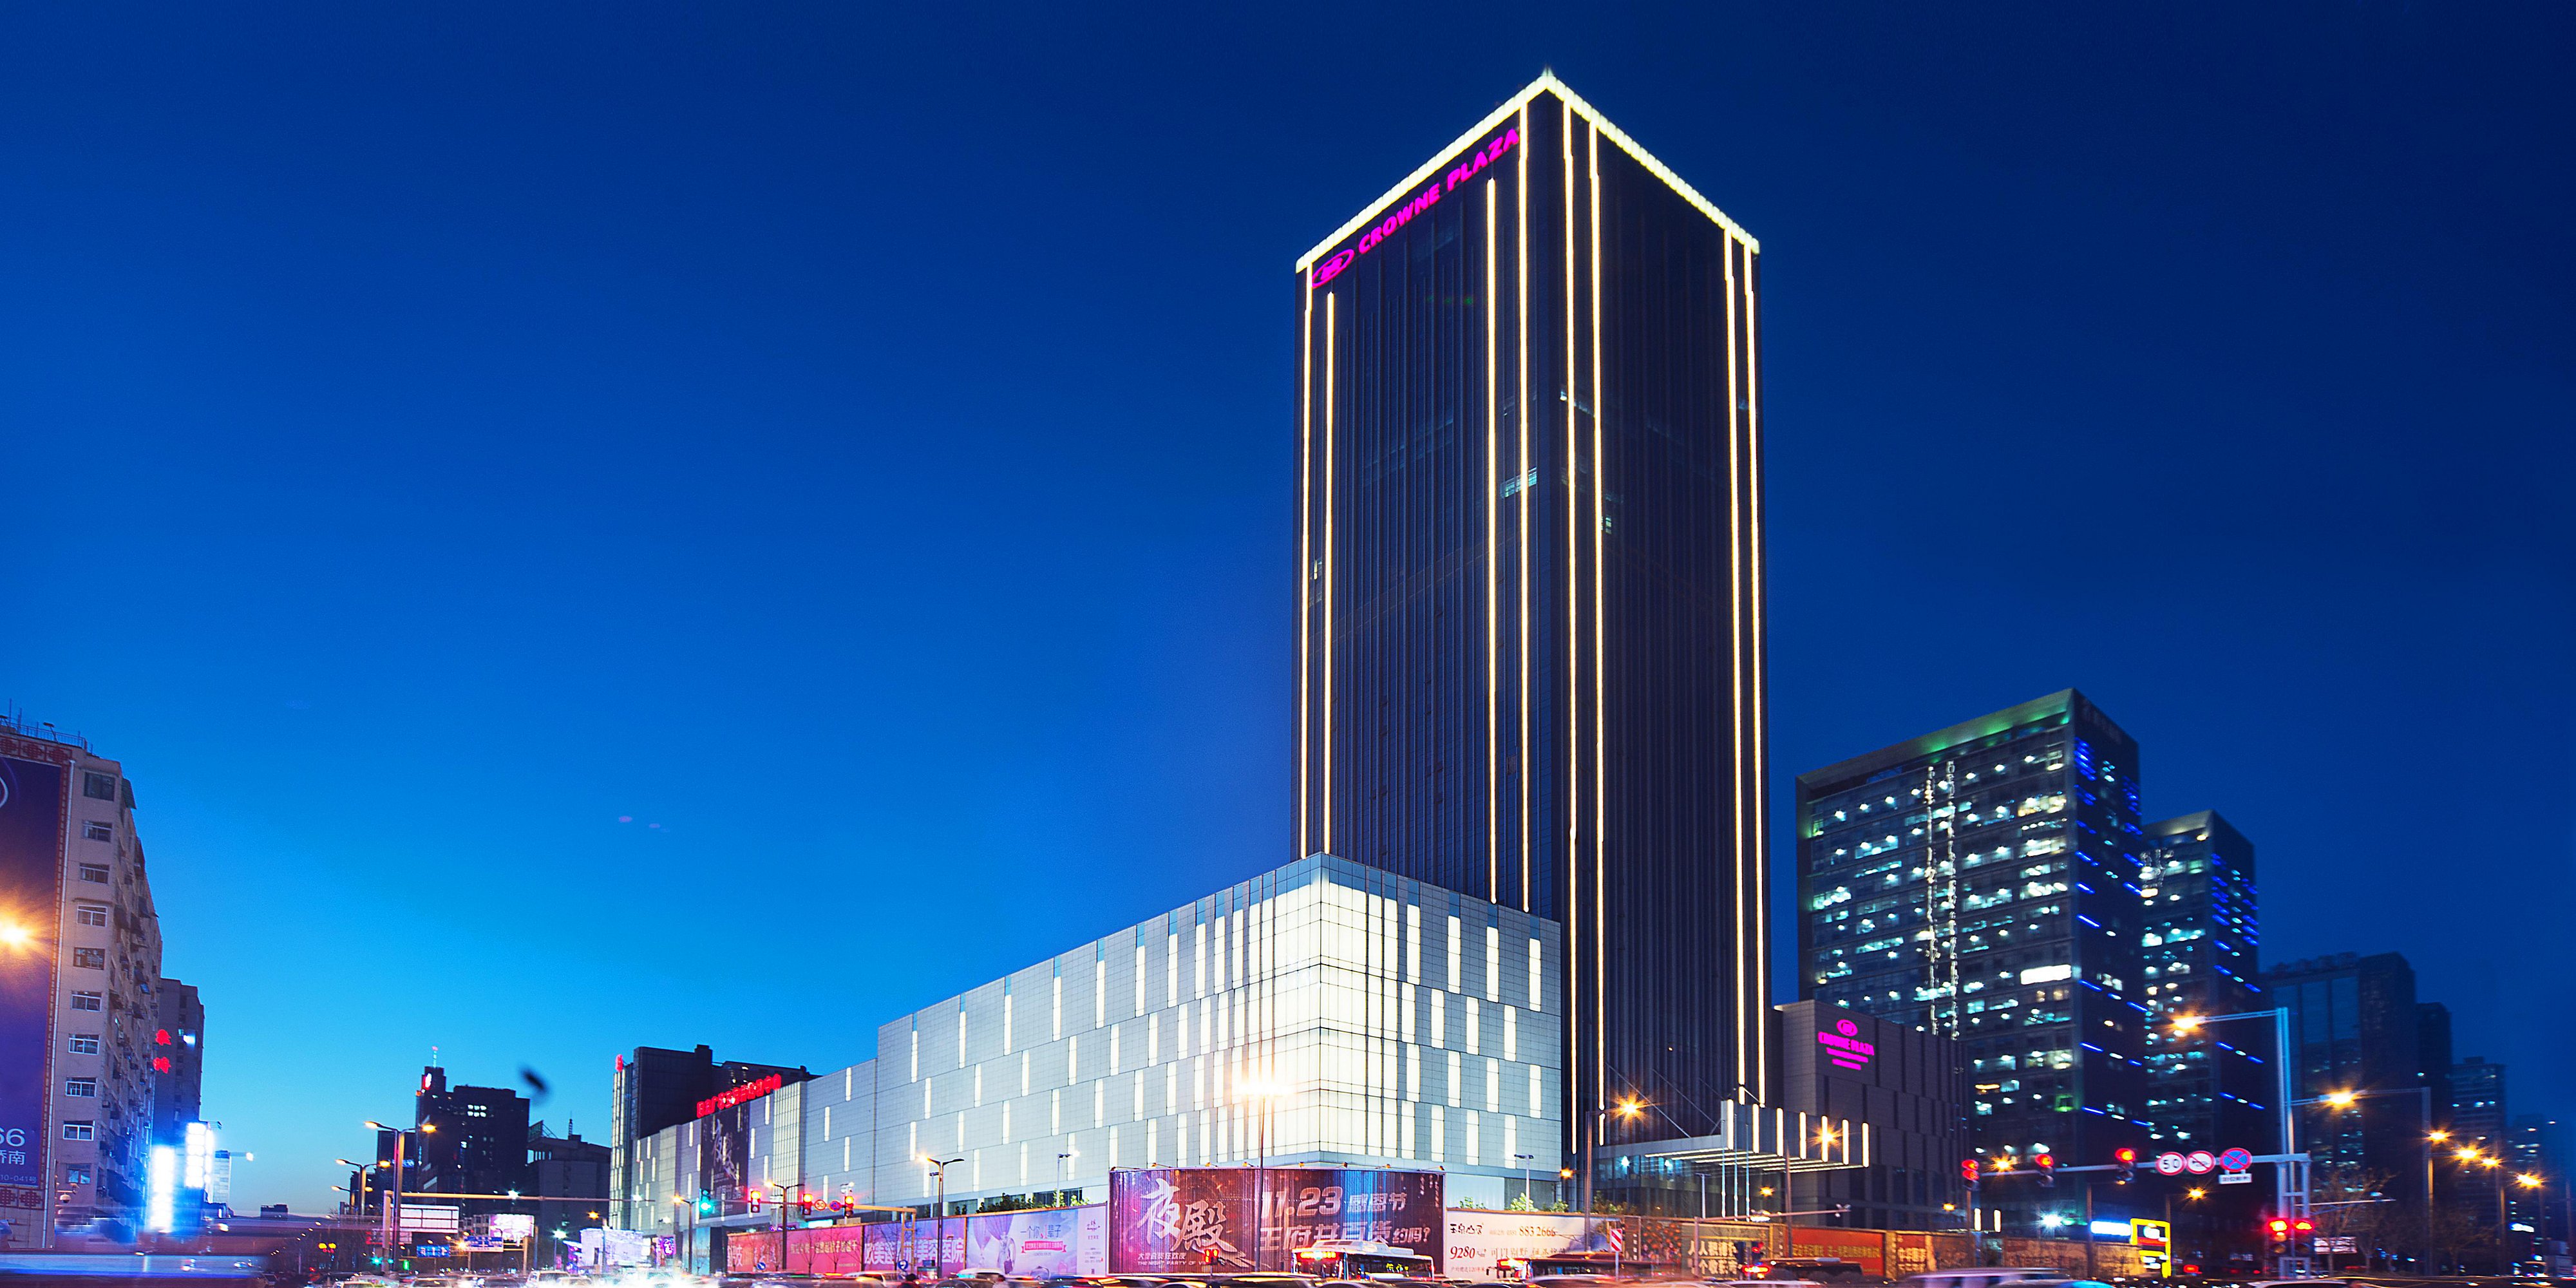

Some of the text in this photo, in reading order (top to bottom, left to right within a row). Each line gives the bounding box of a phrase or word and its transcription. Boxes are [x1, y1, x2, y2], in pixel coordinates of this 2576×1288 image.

[1358, 129, 1520, 254] CROWNE PLAZA
[0, 1127, 25, 1146] 6
[2163, 1159, 2180, 1170] 50
[1260, 1186, 1343, 1219] 11.23
[1347, 1192, 1407, 1213] 感恩节
[1137, 1177, 1238, 1253] 夜殿
[1519, 1226, 1535, 1237] 883
[1537, 1226, 1557, 1237] 2666
[1450, 1246, 1475, 1260] 9280
